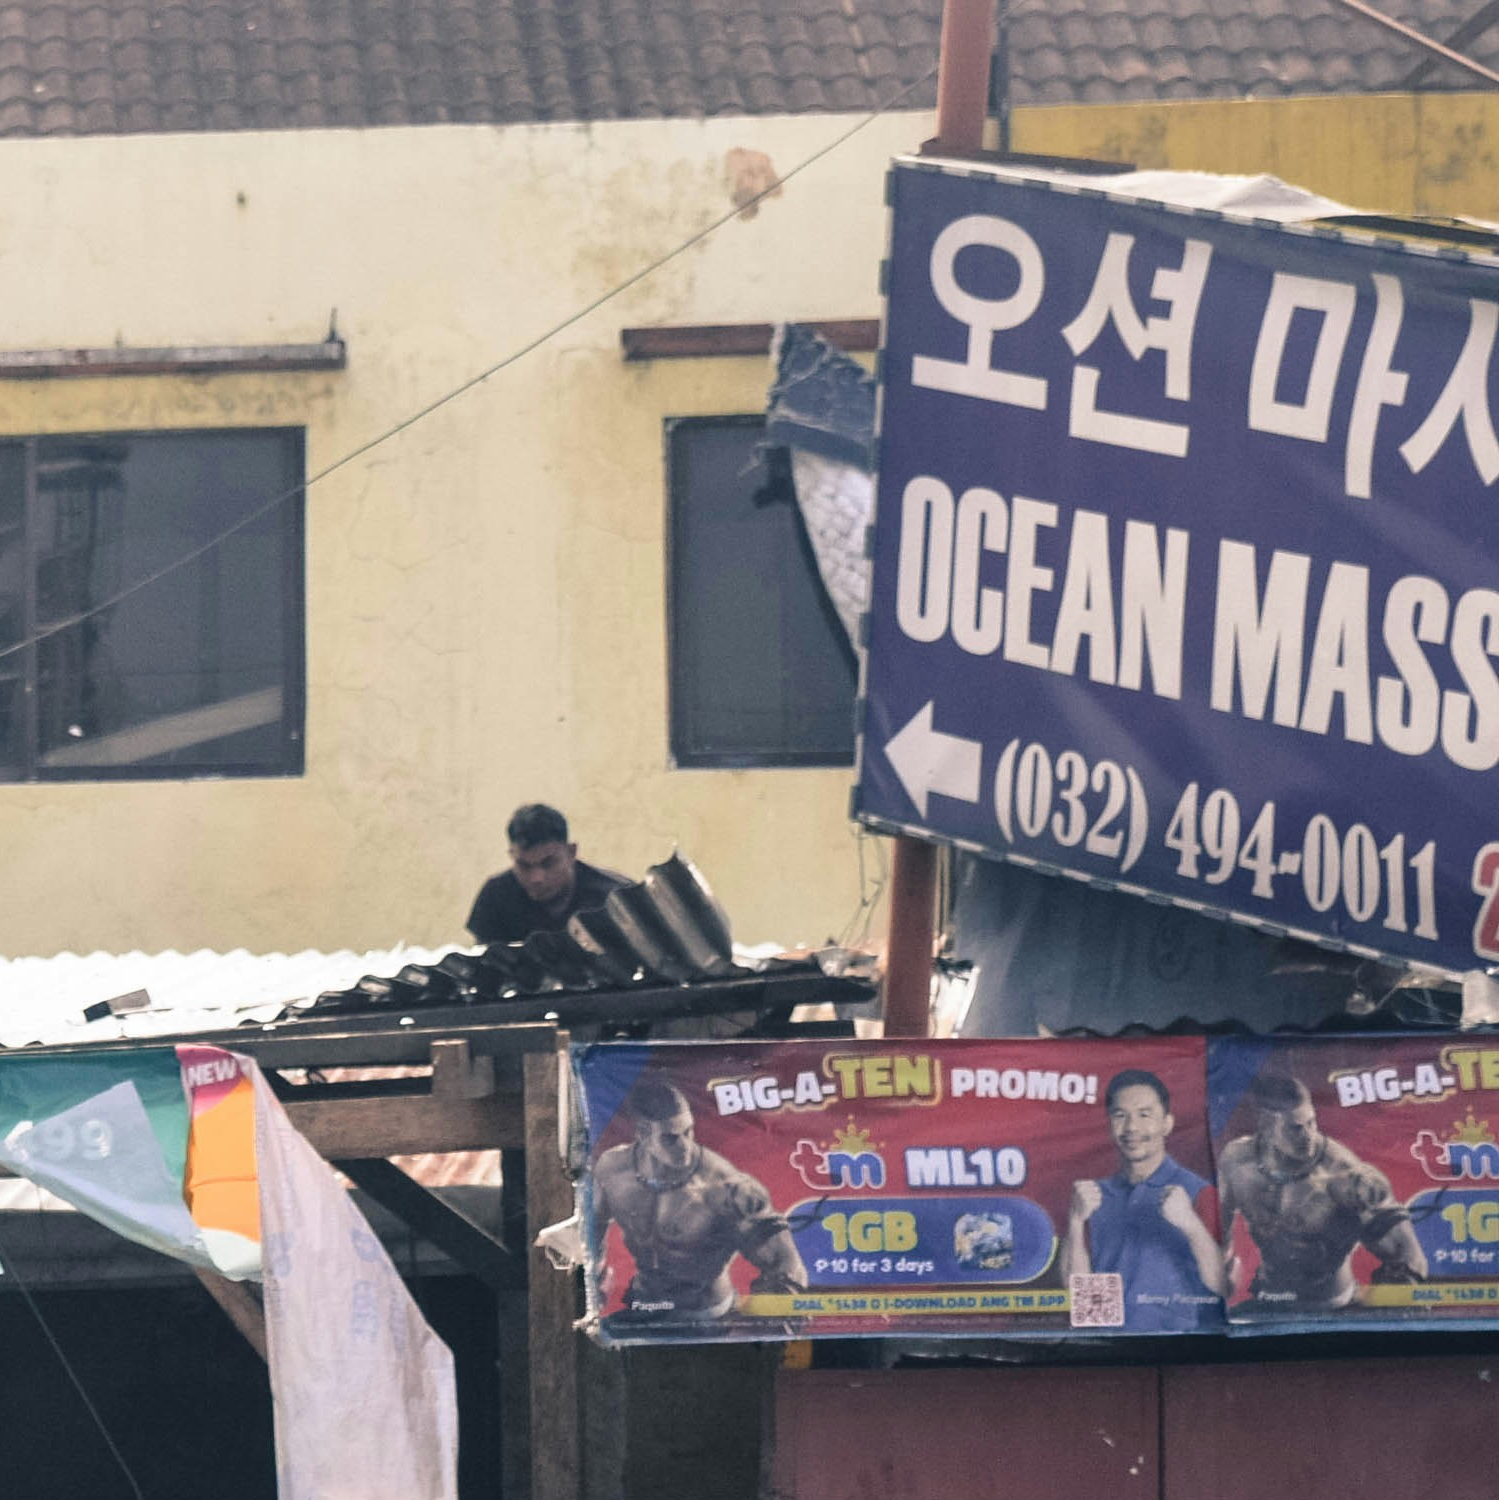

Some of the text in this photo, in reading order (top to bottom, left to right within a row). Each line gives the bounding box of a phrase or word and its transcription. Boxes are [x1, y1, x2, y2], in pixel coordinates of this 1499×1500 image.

[911, 213, 1213, 459] 오션
[896, 474, 1499, 772] OCEAN MASS
[994, 738, 1149, 874] (032)
[1165, 781, 1440, 941] 494-0011
[186, 1057, 238, 1087] NEW
[712, 1055, 1099, 1116] BIG-A-TEN PROMO!
[905, 1146, 1027, 1189] ML10
[821, 1210, 919, 1253] 1GB
[851, 1257, 877, 1273] for
[880, 1258, 893, 1273] 3
[895, 1257, 935, 1276] days
[1470, 1248, 1494, 1264] for
